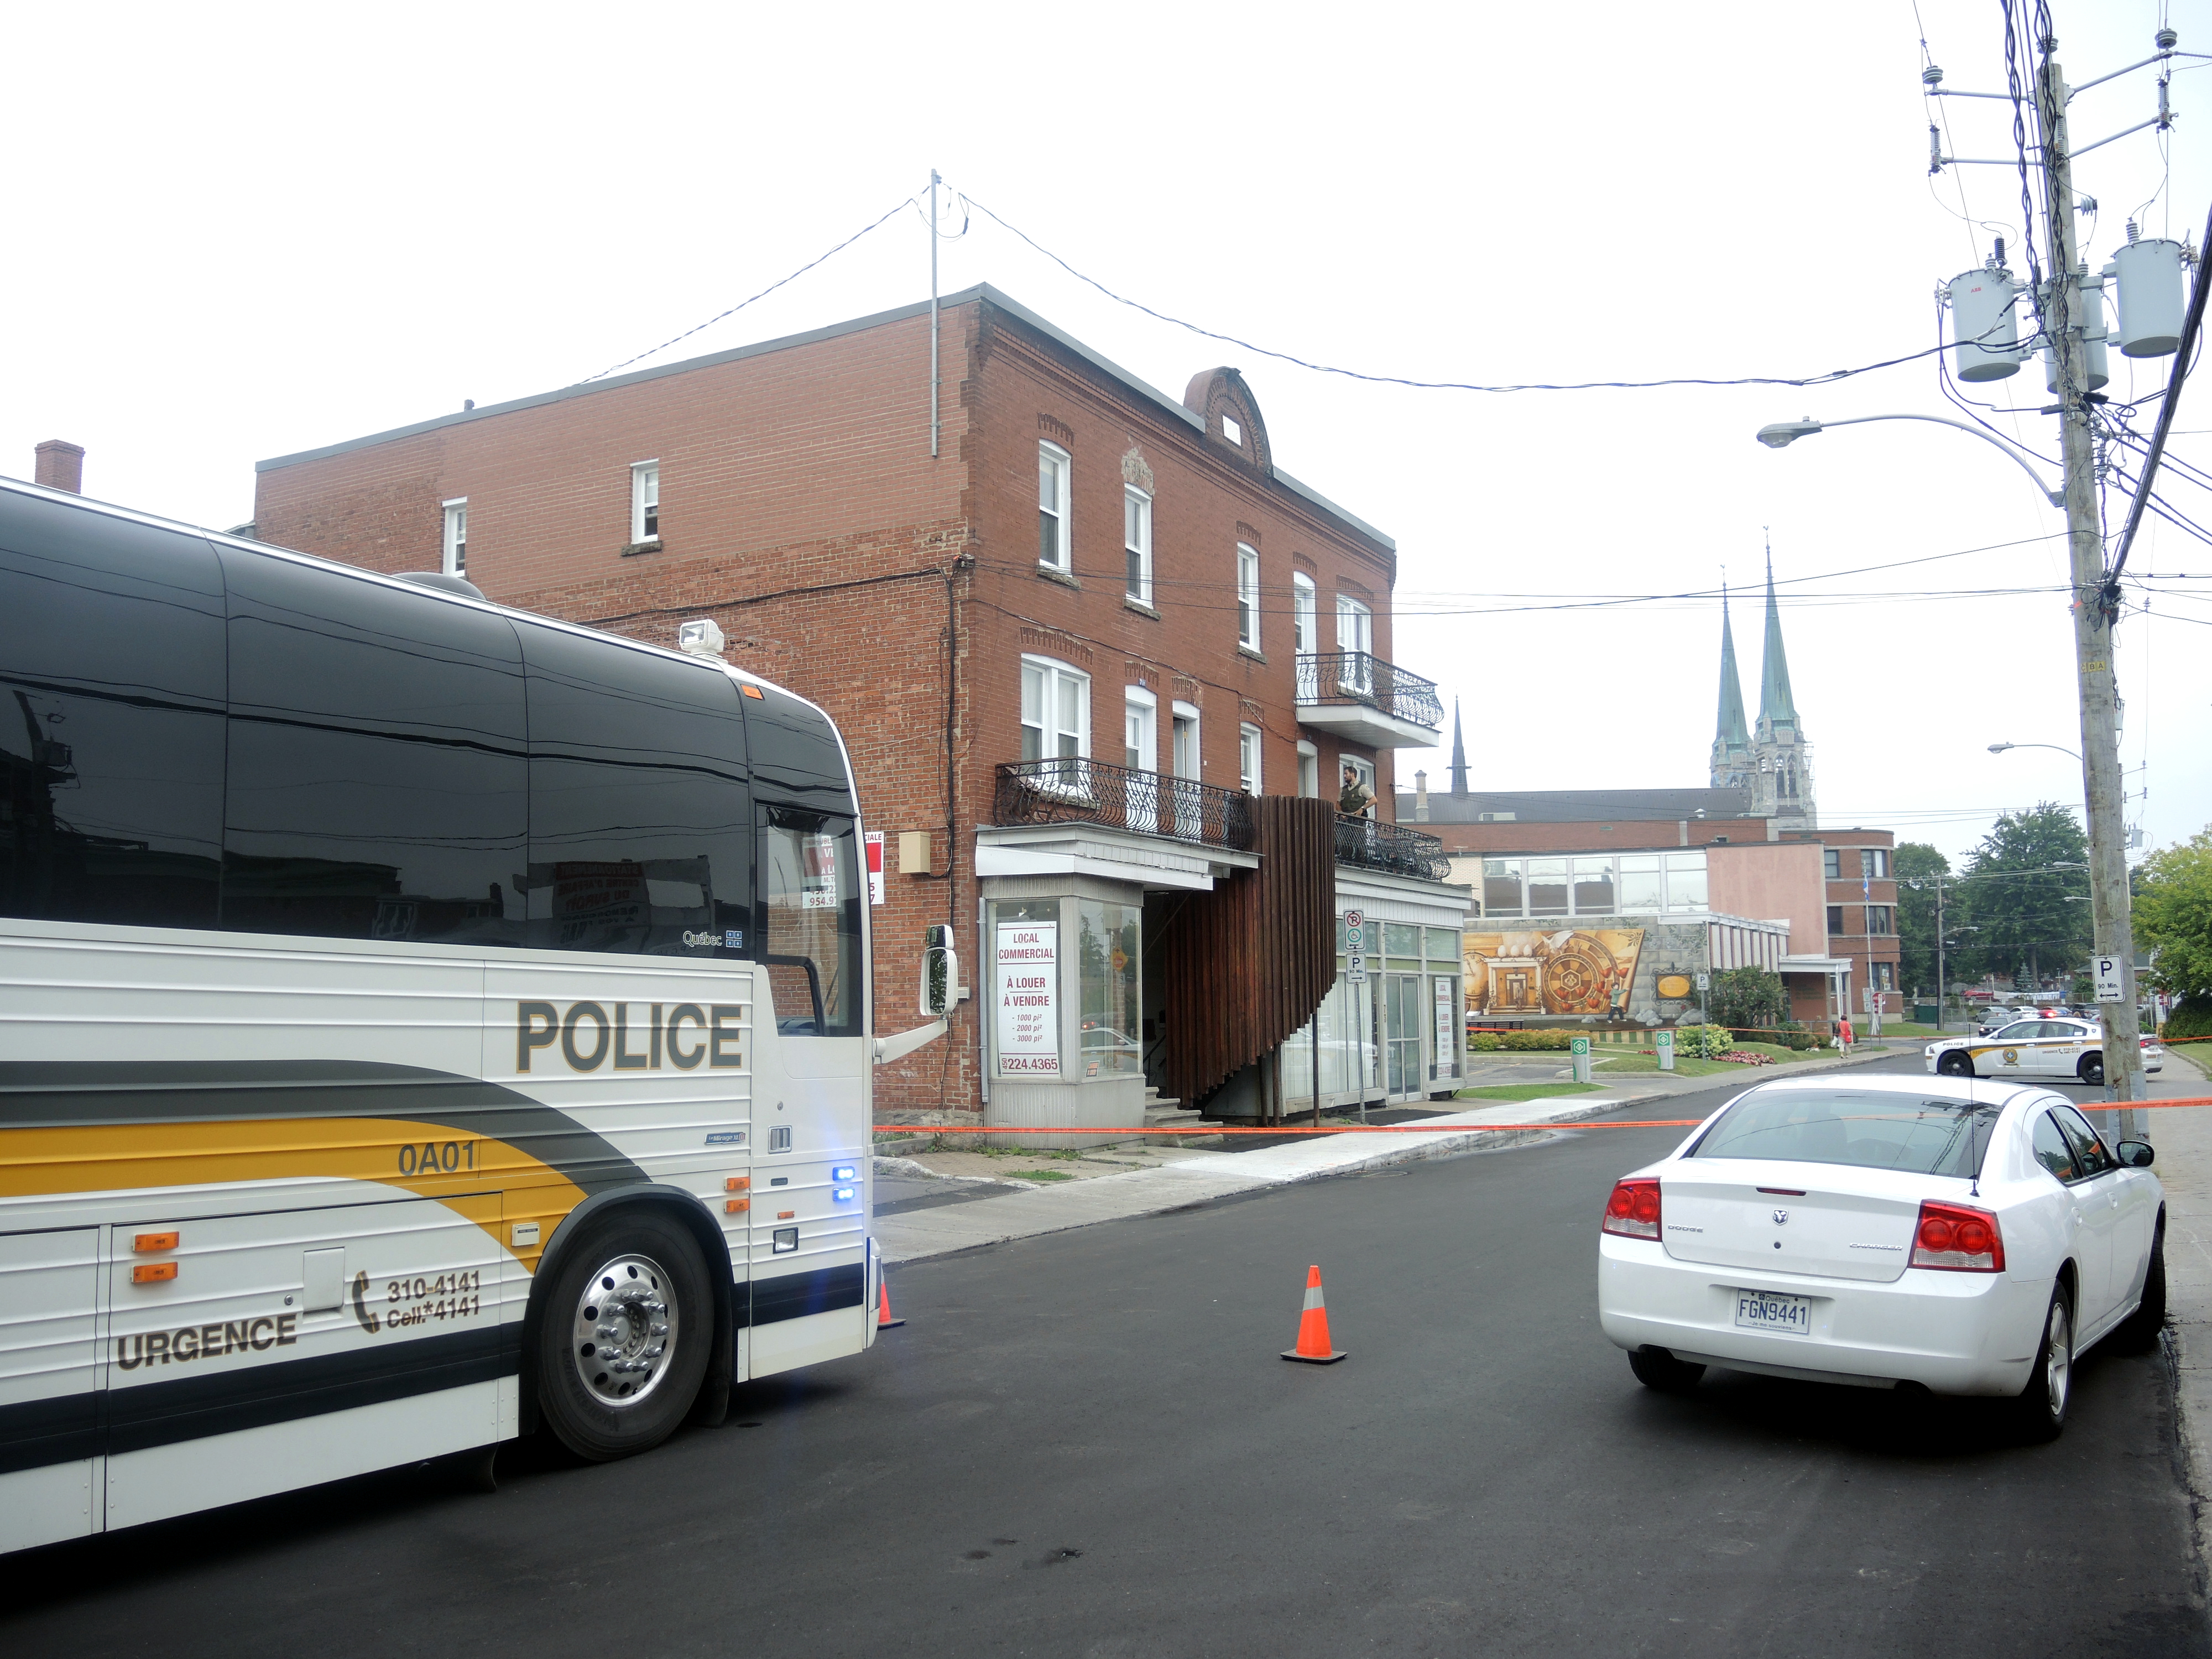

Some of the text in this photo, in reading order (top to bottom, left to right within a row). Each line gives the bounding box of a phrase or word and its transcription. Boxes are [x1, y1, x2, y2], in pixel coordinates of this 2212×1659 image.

[810, 896, 836, 906] 954.9
[683, 931, 722, 947] Québec
[1014, 933, 1039, 943] LOCAL
[999, 948, 1054, 959] COMMERCIAL
[1352, 957, 1360, 968] P
[2100, 961, 2112, 977] P
[1007, 975, 1046, 988] À LOUER
[1004, 994, 1050, 1006] À VENDRE
[516, 1000, 742, 1073] POLICE
[1008, 1058, 1058, 1070] 224.4365
[399, 1140, 474, 1176] 0A01
[1668, 1224, 1703, 1233] DODGE
[388, 1270, 479, 1303] 310-4141
[1739, 1299, 1806, 1325] FGN9441
[117, 1313, 297, 1371] URGENCE
